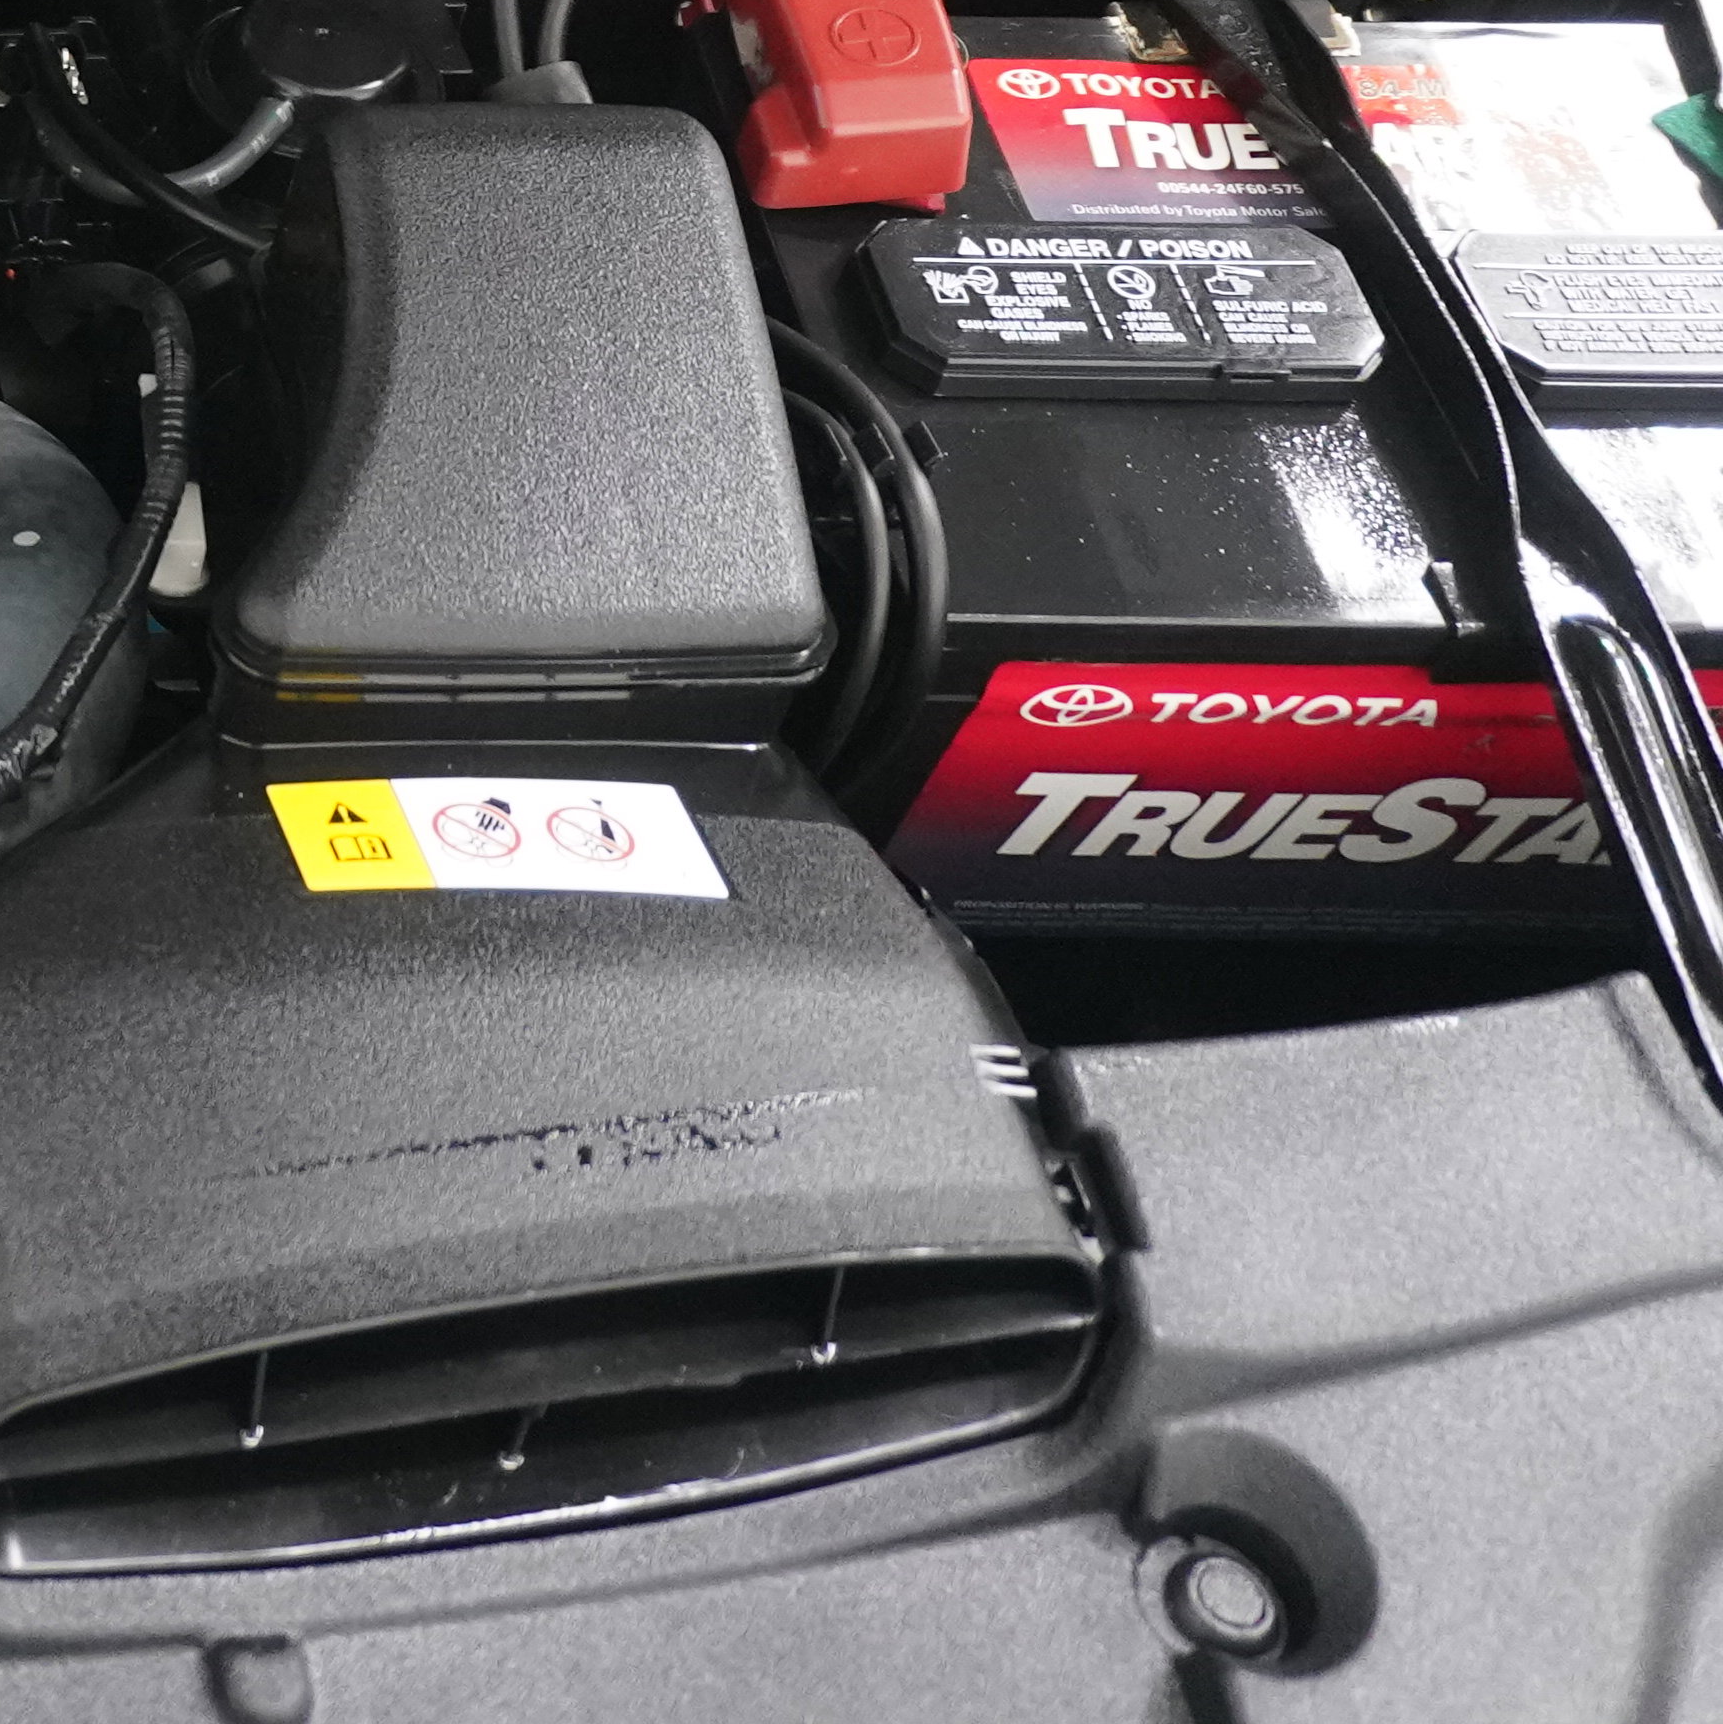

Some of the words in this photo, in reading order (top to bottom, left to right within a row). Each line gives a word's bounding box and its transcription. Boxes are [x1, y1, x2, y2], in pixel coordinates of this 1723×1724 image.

[1060, 72, 1226, 99] TOYOTA
[1071, 202, 1160, 217] Distributed
[1167, 204, 1183, 219] by
[1184, 205, 1238, 219] Toyota
[1242, 205, 1288, 218] Motor
[1293, 206, 1327, 218] Sale
[984, 238, 1112, 258] DANGER
[1139, 239, 1254, 259] POISON
[1010, 271, 1067, 284] SHIELD
[1554, 274, 1603, 287] FLUSH
[1605, 275, 1647, 287] EYES
[1015, 284, 1058, 295] EYES
[1559, 288, 1601, 300] WITH
[984, 295, 1071, 308] EXPLOSIVE
[1127, 299, 1153, 310] NO
[1212, 300, 1290, 312] SULFURIC
[1291, 301, 1328, 313] ACID
[1567, 300, 1638, 313] MEDICAL
[1639, 301, 1676, 313] HELP
[990, 307, 1045, 319] GASES
[1149, 692, 1439, 728] TOYOTA
[996, 772, 1611, 866] TRUESTA
